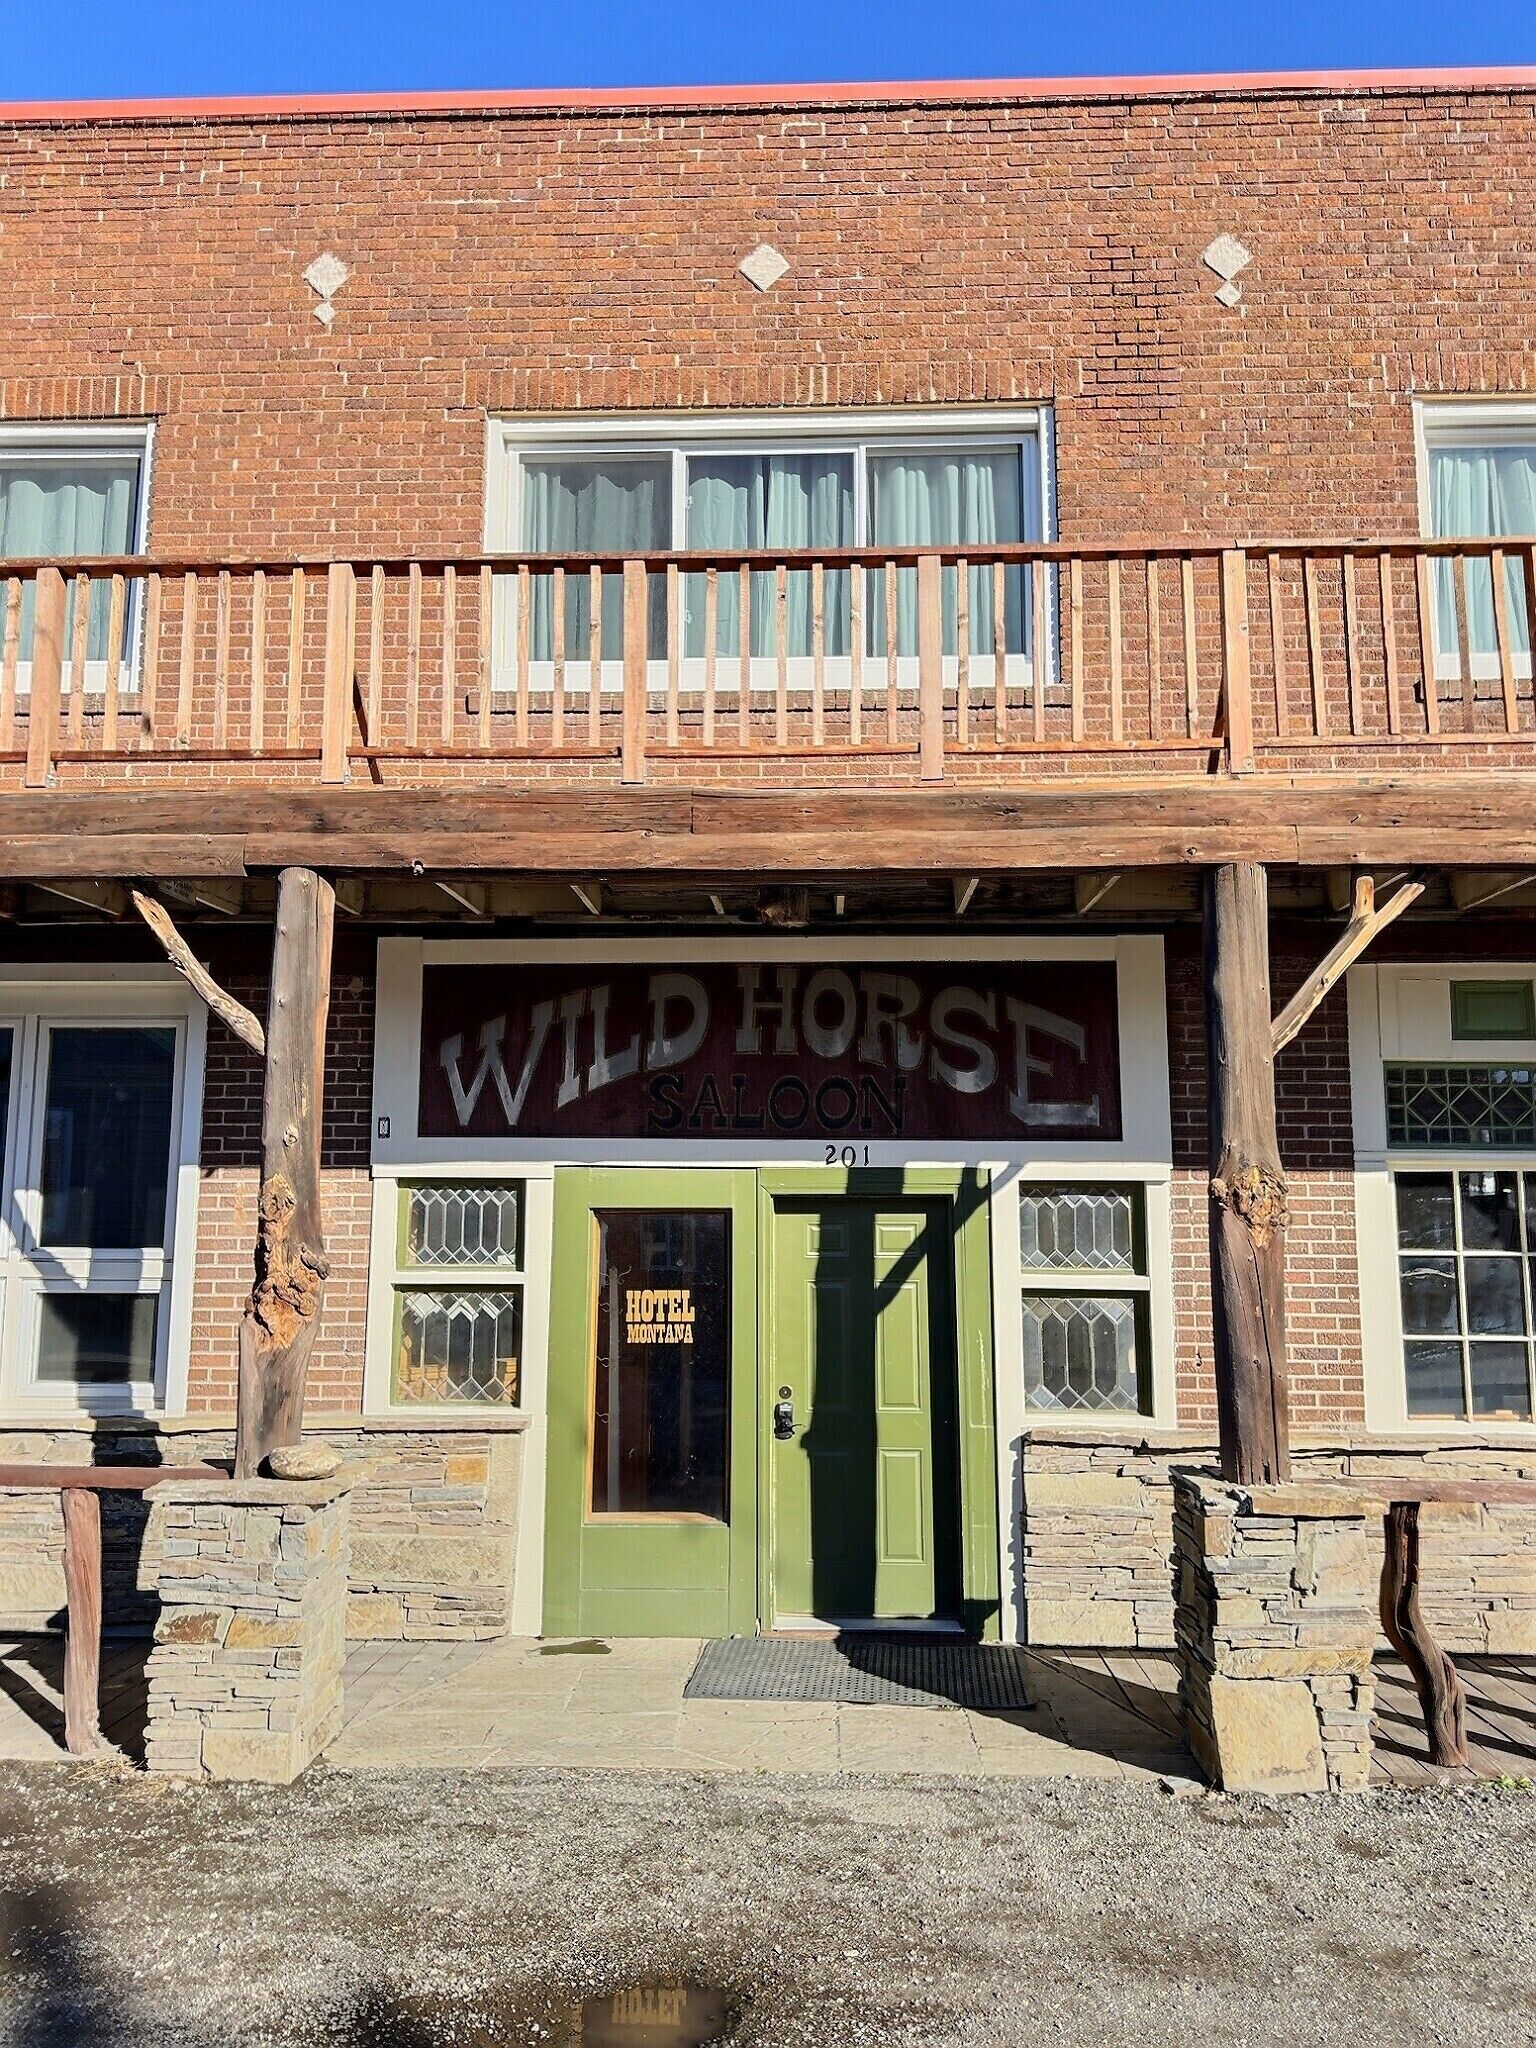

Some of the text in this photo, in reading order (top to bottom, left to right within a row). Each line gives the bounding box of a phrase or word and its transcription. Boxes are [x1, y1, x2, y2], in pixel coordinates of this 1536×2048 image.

[440, 966, 1100, 1127] WILD HORSE
[648, 1073, 907, 1134] SALOON
[825, 1144, 870, 1168] 201
[625, 1289, 696, 1323] HOTEL
[626, 1323, 694, 1344] MONTANA
